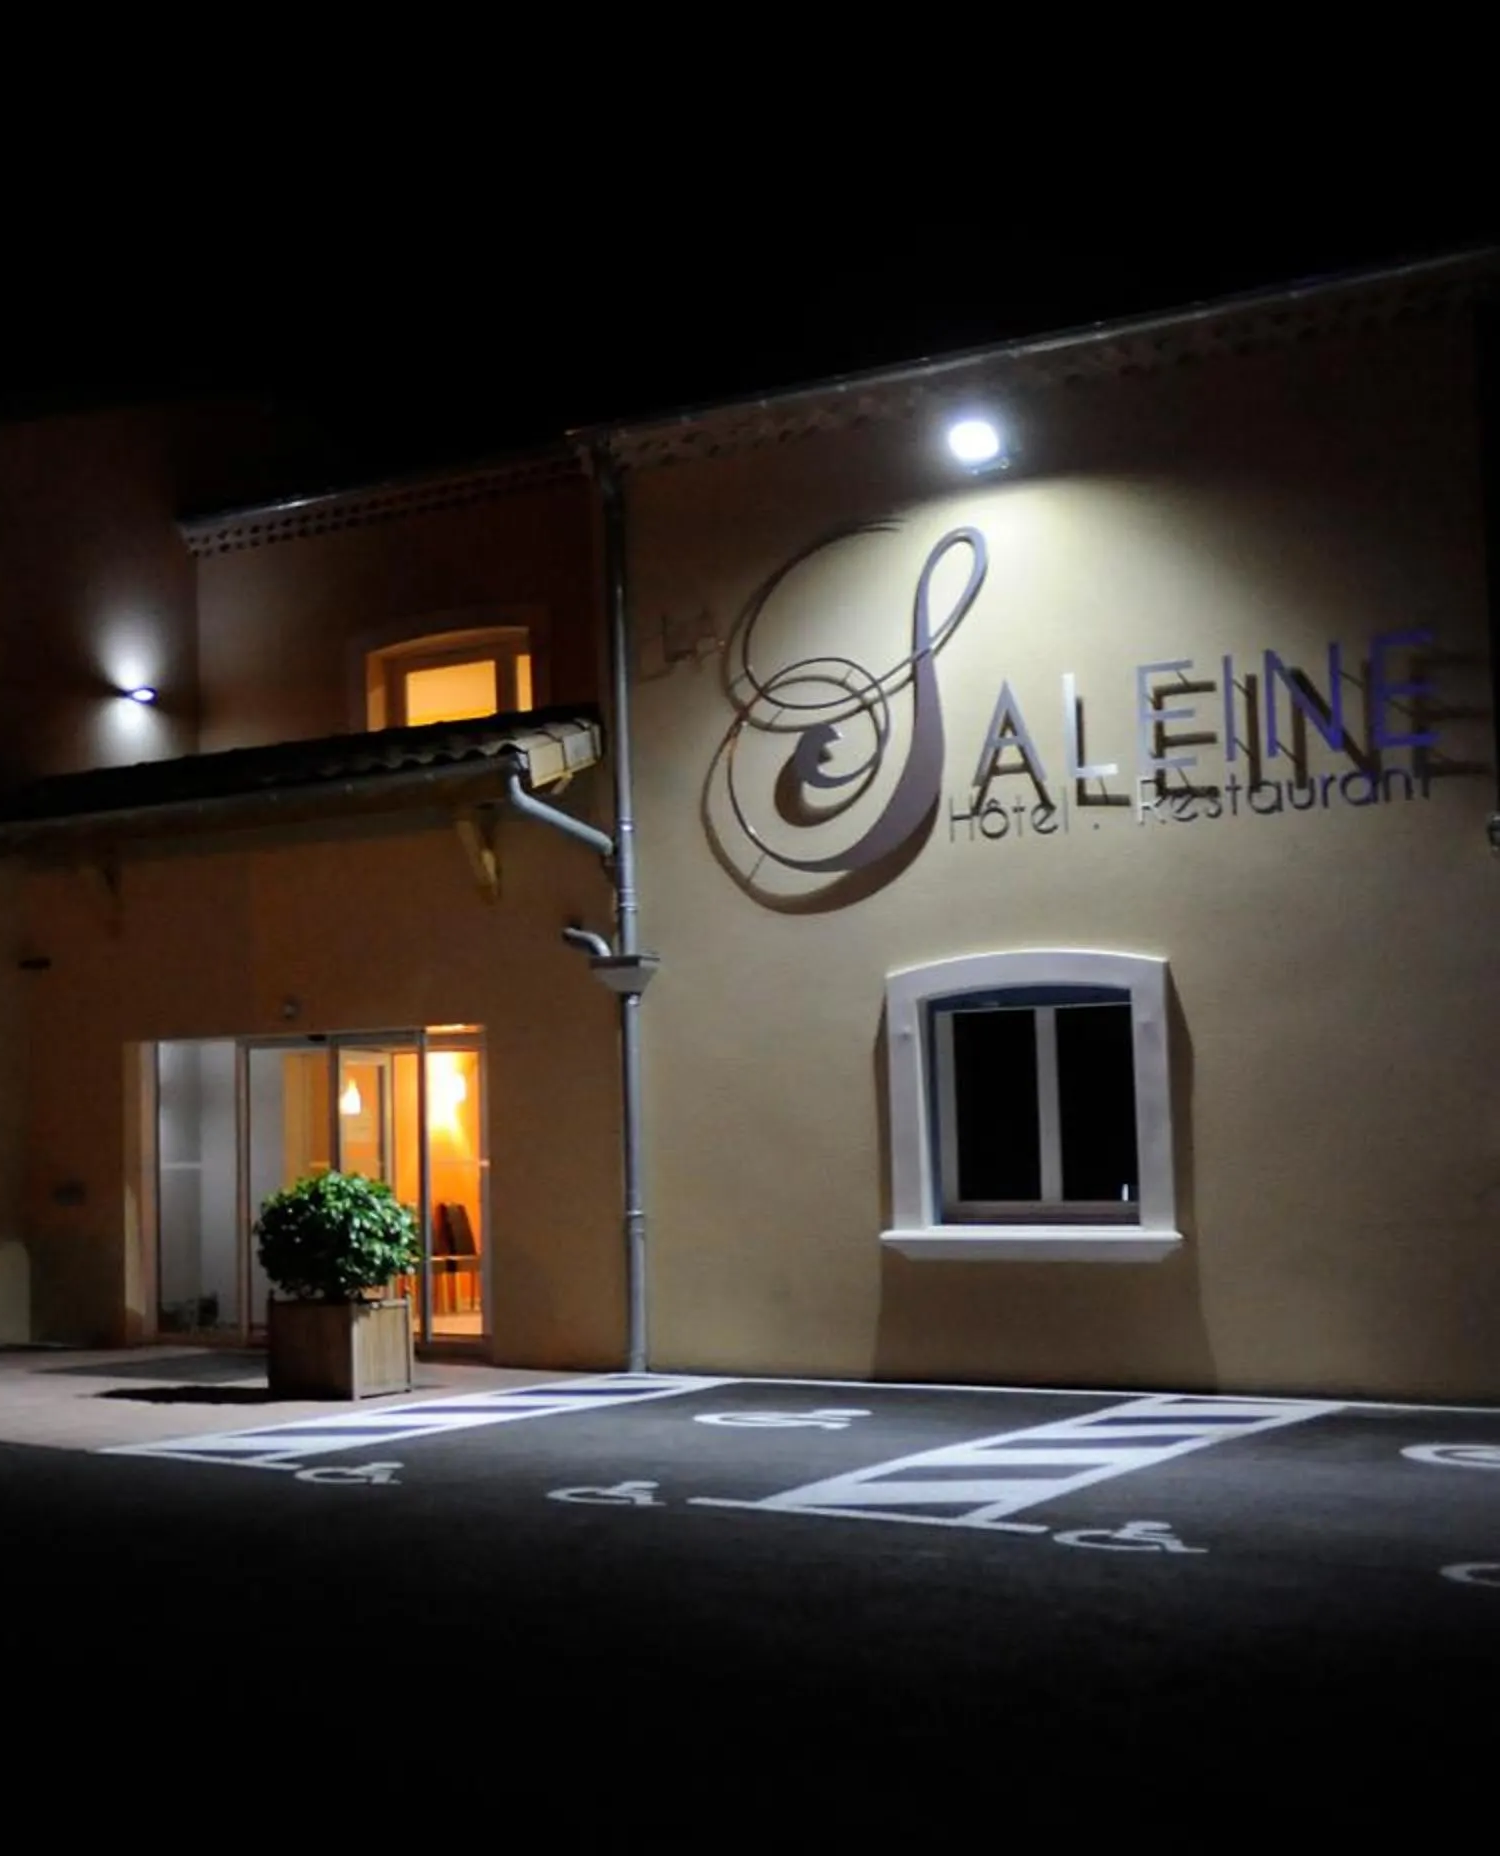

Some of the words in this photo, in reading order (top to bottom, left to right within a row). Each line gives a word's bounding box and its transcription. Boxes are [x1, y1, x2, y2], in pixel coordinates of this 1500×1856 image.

[728, 521, 1441, 872] SALEINE
[950, 786, 1068, 842] Hôtel
[1137, 760, 1433, 825] Restaurant
